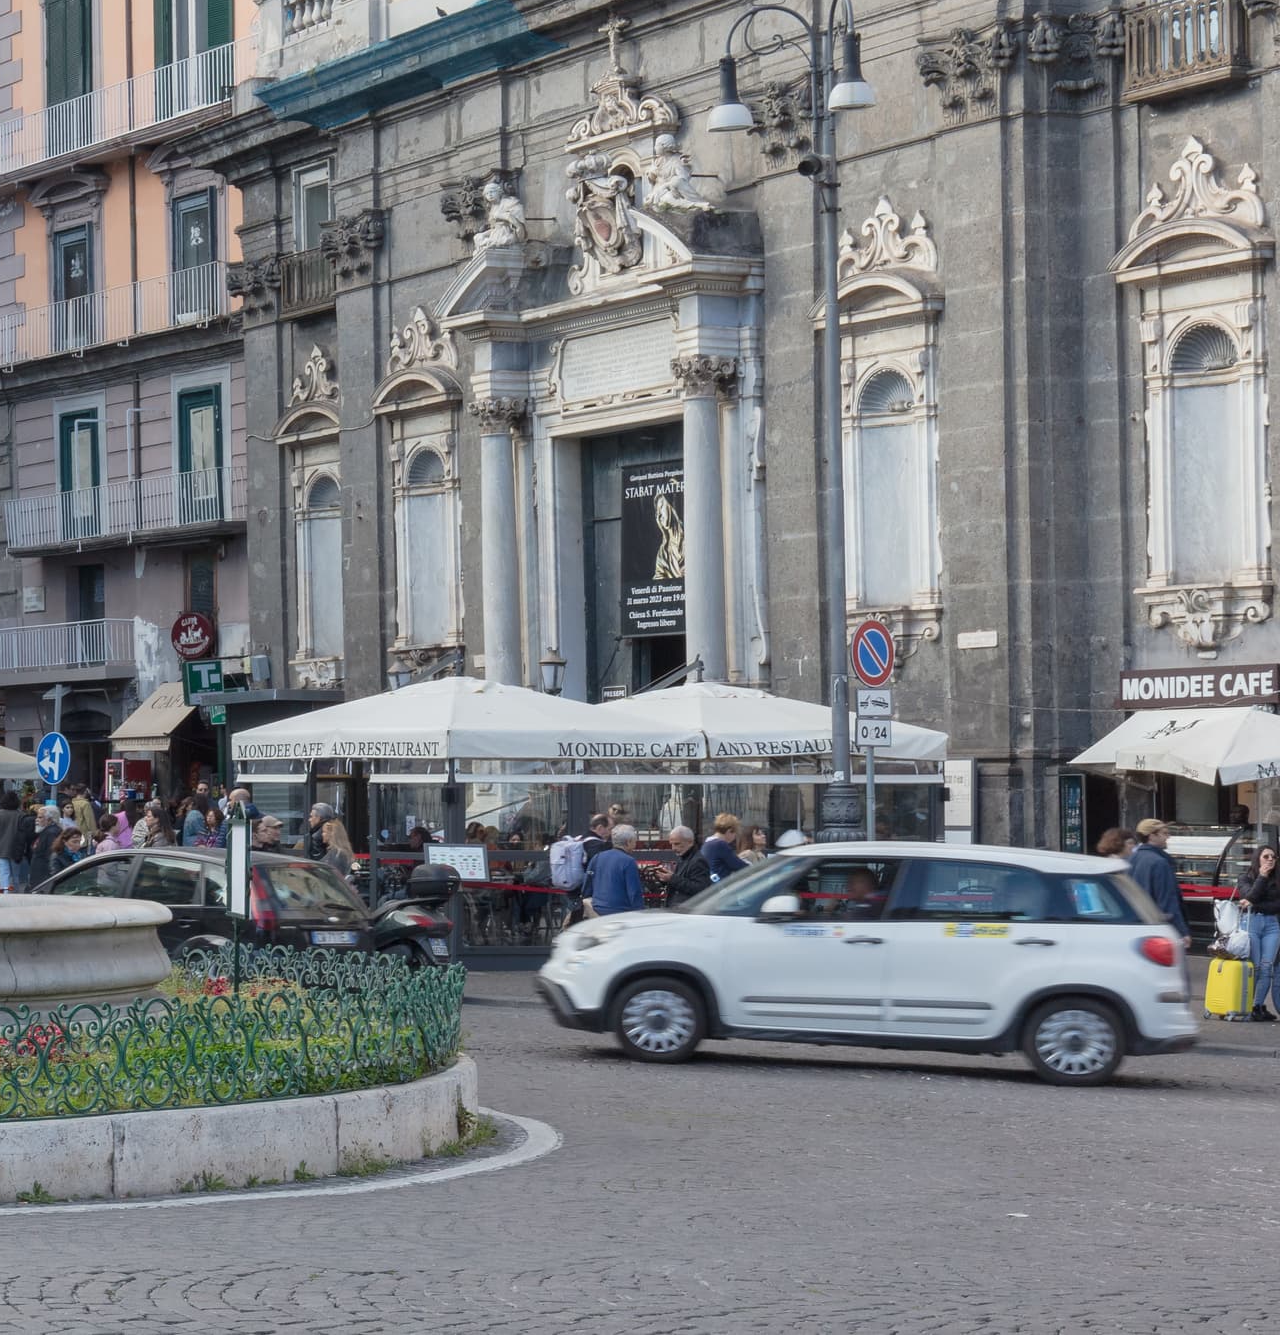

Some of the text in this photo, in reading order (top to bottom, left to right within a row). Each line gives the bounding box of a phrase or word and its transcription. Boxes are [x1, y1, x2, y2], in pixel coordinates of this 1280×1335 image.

[625, 485, 654, 499] STABAT
[1122, 669, 1273, 701] MONIDEE CAFÉ
[874, 726, 888, 739] 24
[238, 744, 291, 759] MONIDEE
[331, 742, 356, 756] AND
[360, 741, 440, 756] RESTAURANT
[557, 742, 648, 758] MONIDEE
[716, 742, 752, 756] AND
